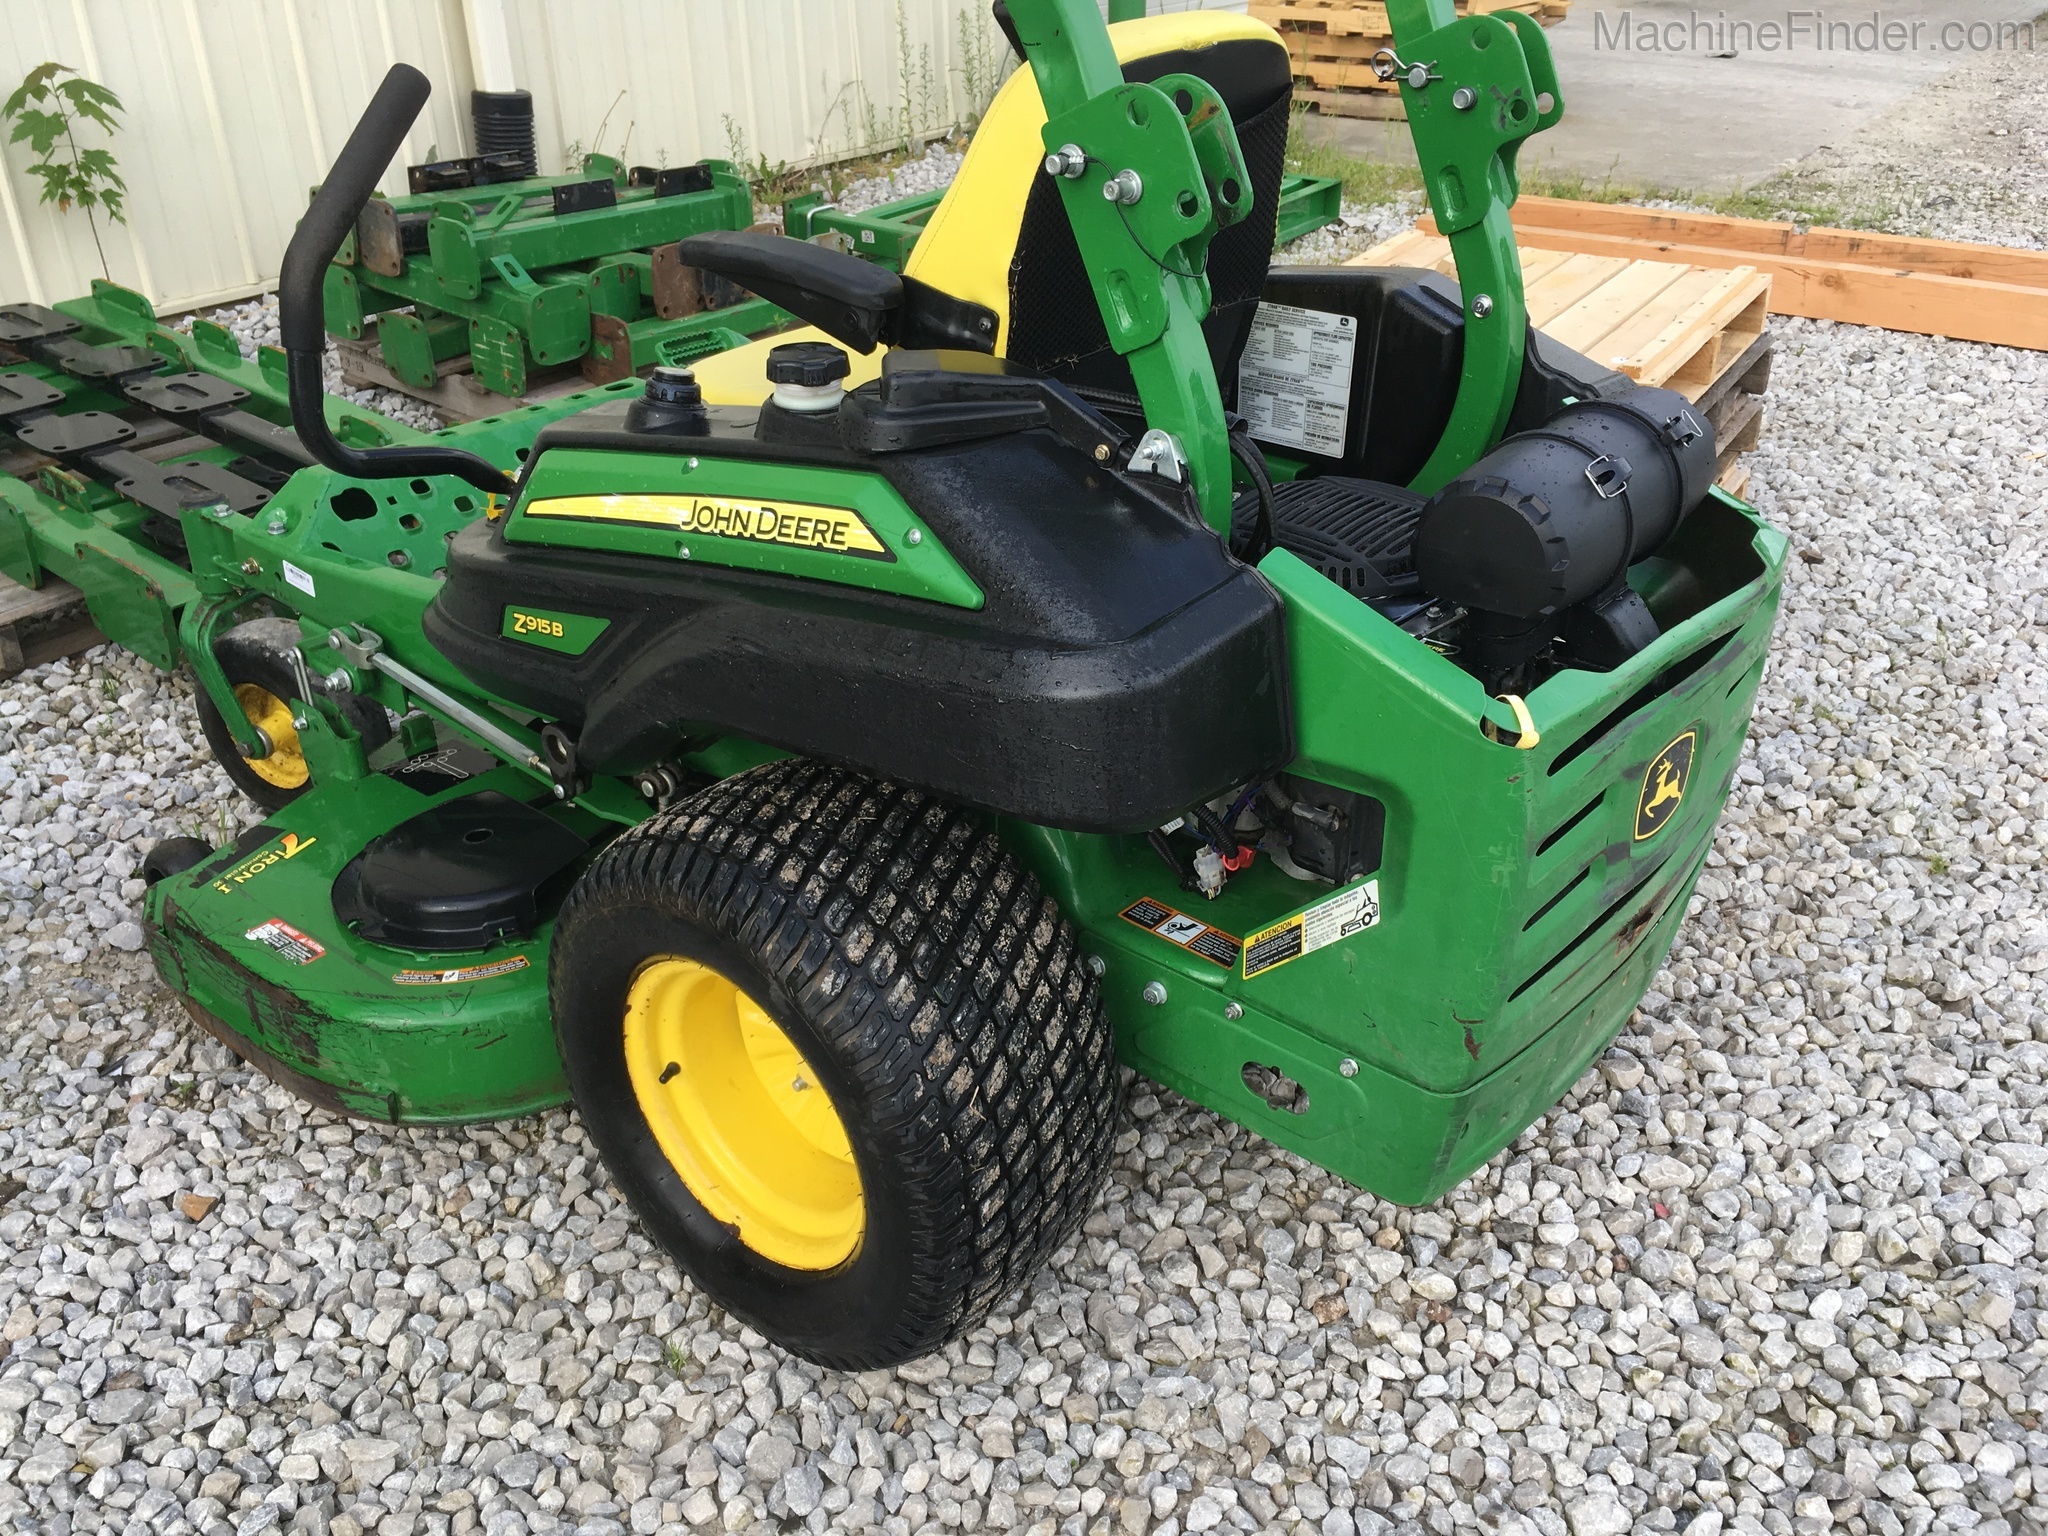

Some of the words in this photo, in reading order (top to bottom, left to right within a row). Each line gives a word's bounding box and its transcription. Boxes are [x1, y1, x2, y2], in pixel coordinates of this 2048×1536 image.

[682, 500, 753, 534] JOHN
[757, 507, 850, 547] DEERE
[513, 612, 564, 638] Z915B
[1260, 920, 1292, 940] ATENCION
